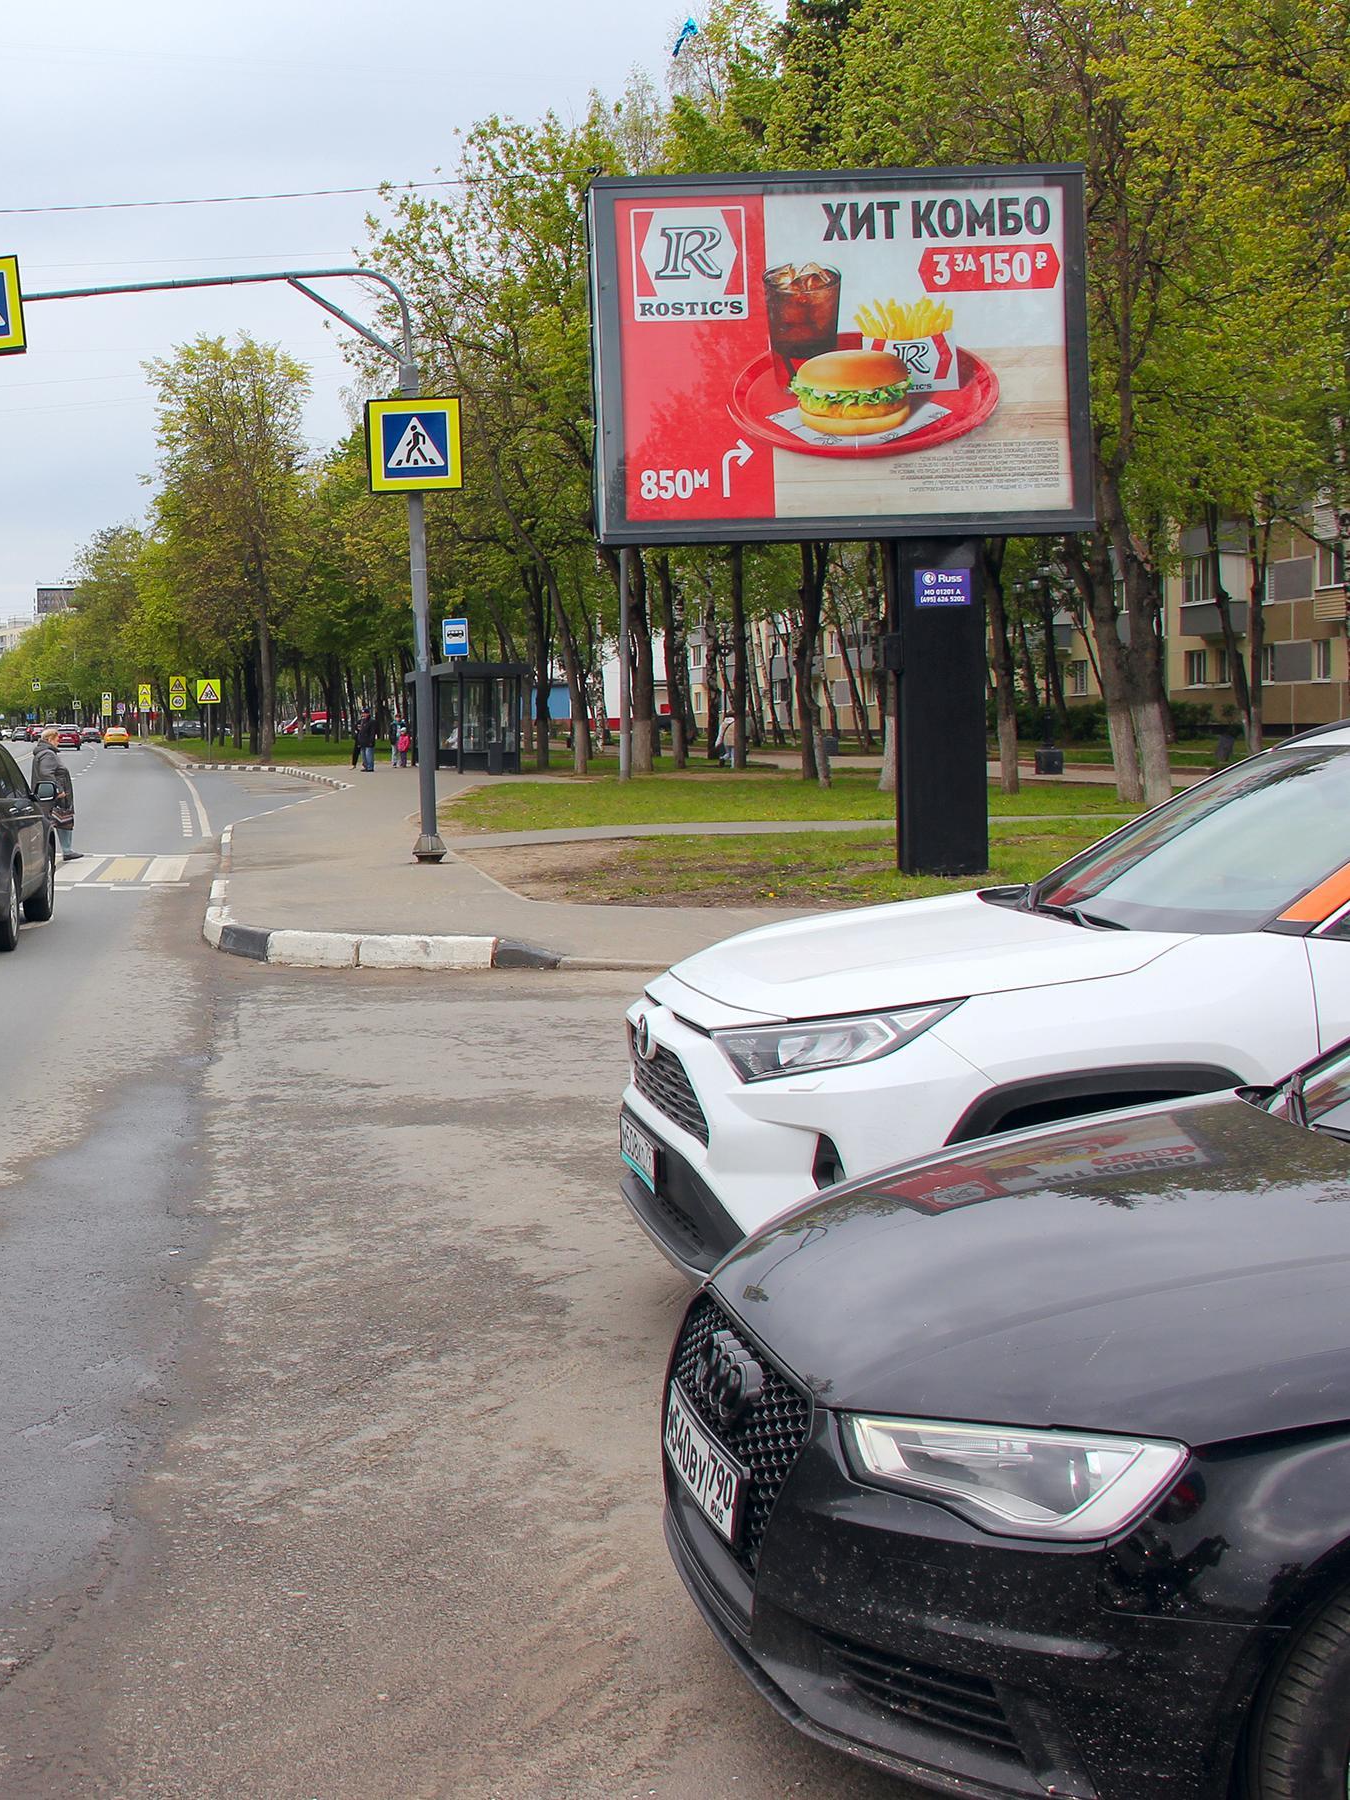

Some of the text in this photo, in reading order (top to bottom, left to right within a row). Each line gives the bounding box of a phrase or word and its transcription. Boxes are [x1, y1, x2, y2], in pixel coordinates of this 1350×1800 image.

[822, 196, 1051, 241] ХИТ КОМБО
[639, 301, 744, 316] ROSTIC'S
[708, 1453, 733, 1510] 790
[710, 1500, 724, 1524] RUS
